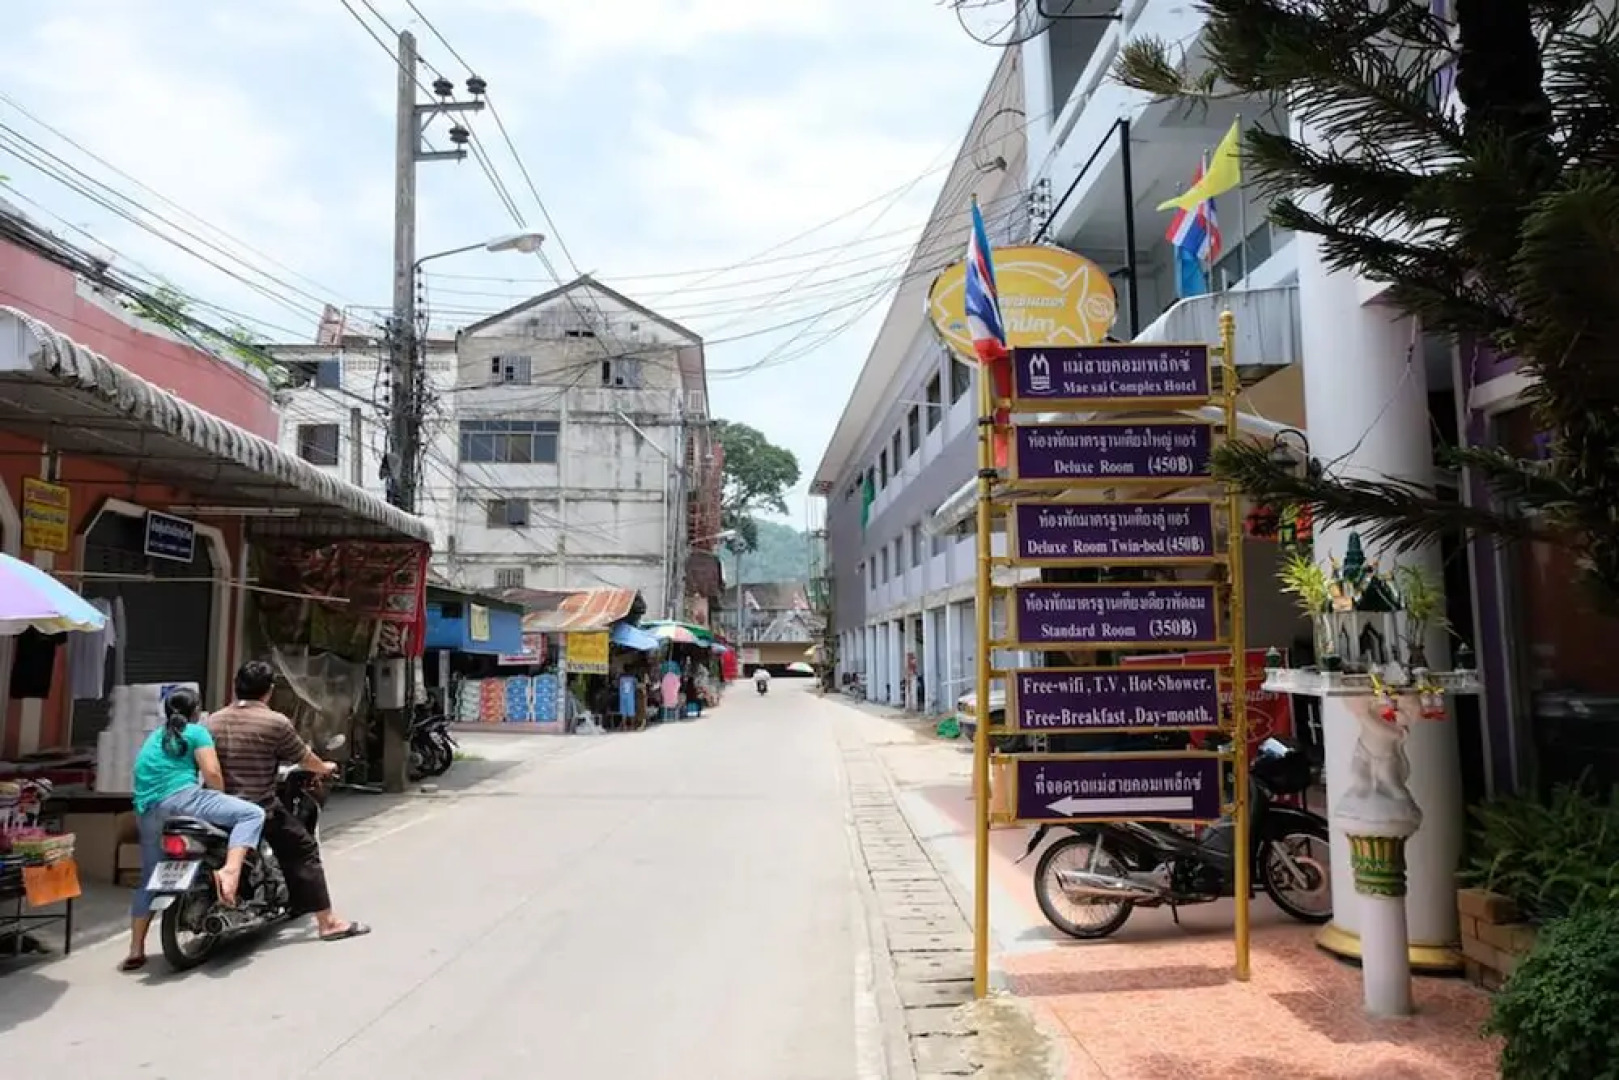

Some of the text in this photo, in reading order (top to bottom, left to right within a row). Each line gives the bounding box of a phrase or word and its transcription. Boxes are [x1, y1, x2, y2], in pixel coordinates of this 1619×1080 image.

[1063, 381, 1088, 393] Mae
[1109, 380, 1160, 395] Complex
[1164, 379, 1196, 391] Hotel
[1054, 460, 1094, 474] Deluxe
[1100, 460, 1134, 473] Room
[1028, 540, 1067, 554] Deluxe
[1073, 539, 1108, 553] Room
[1109, 538, 1164, 552] Twin-bed
[1041, 623, 1095, 637] Standard
[1102, 623, 1136, 637] Room
[1135, 706, 1213, 727] Day-month.
